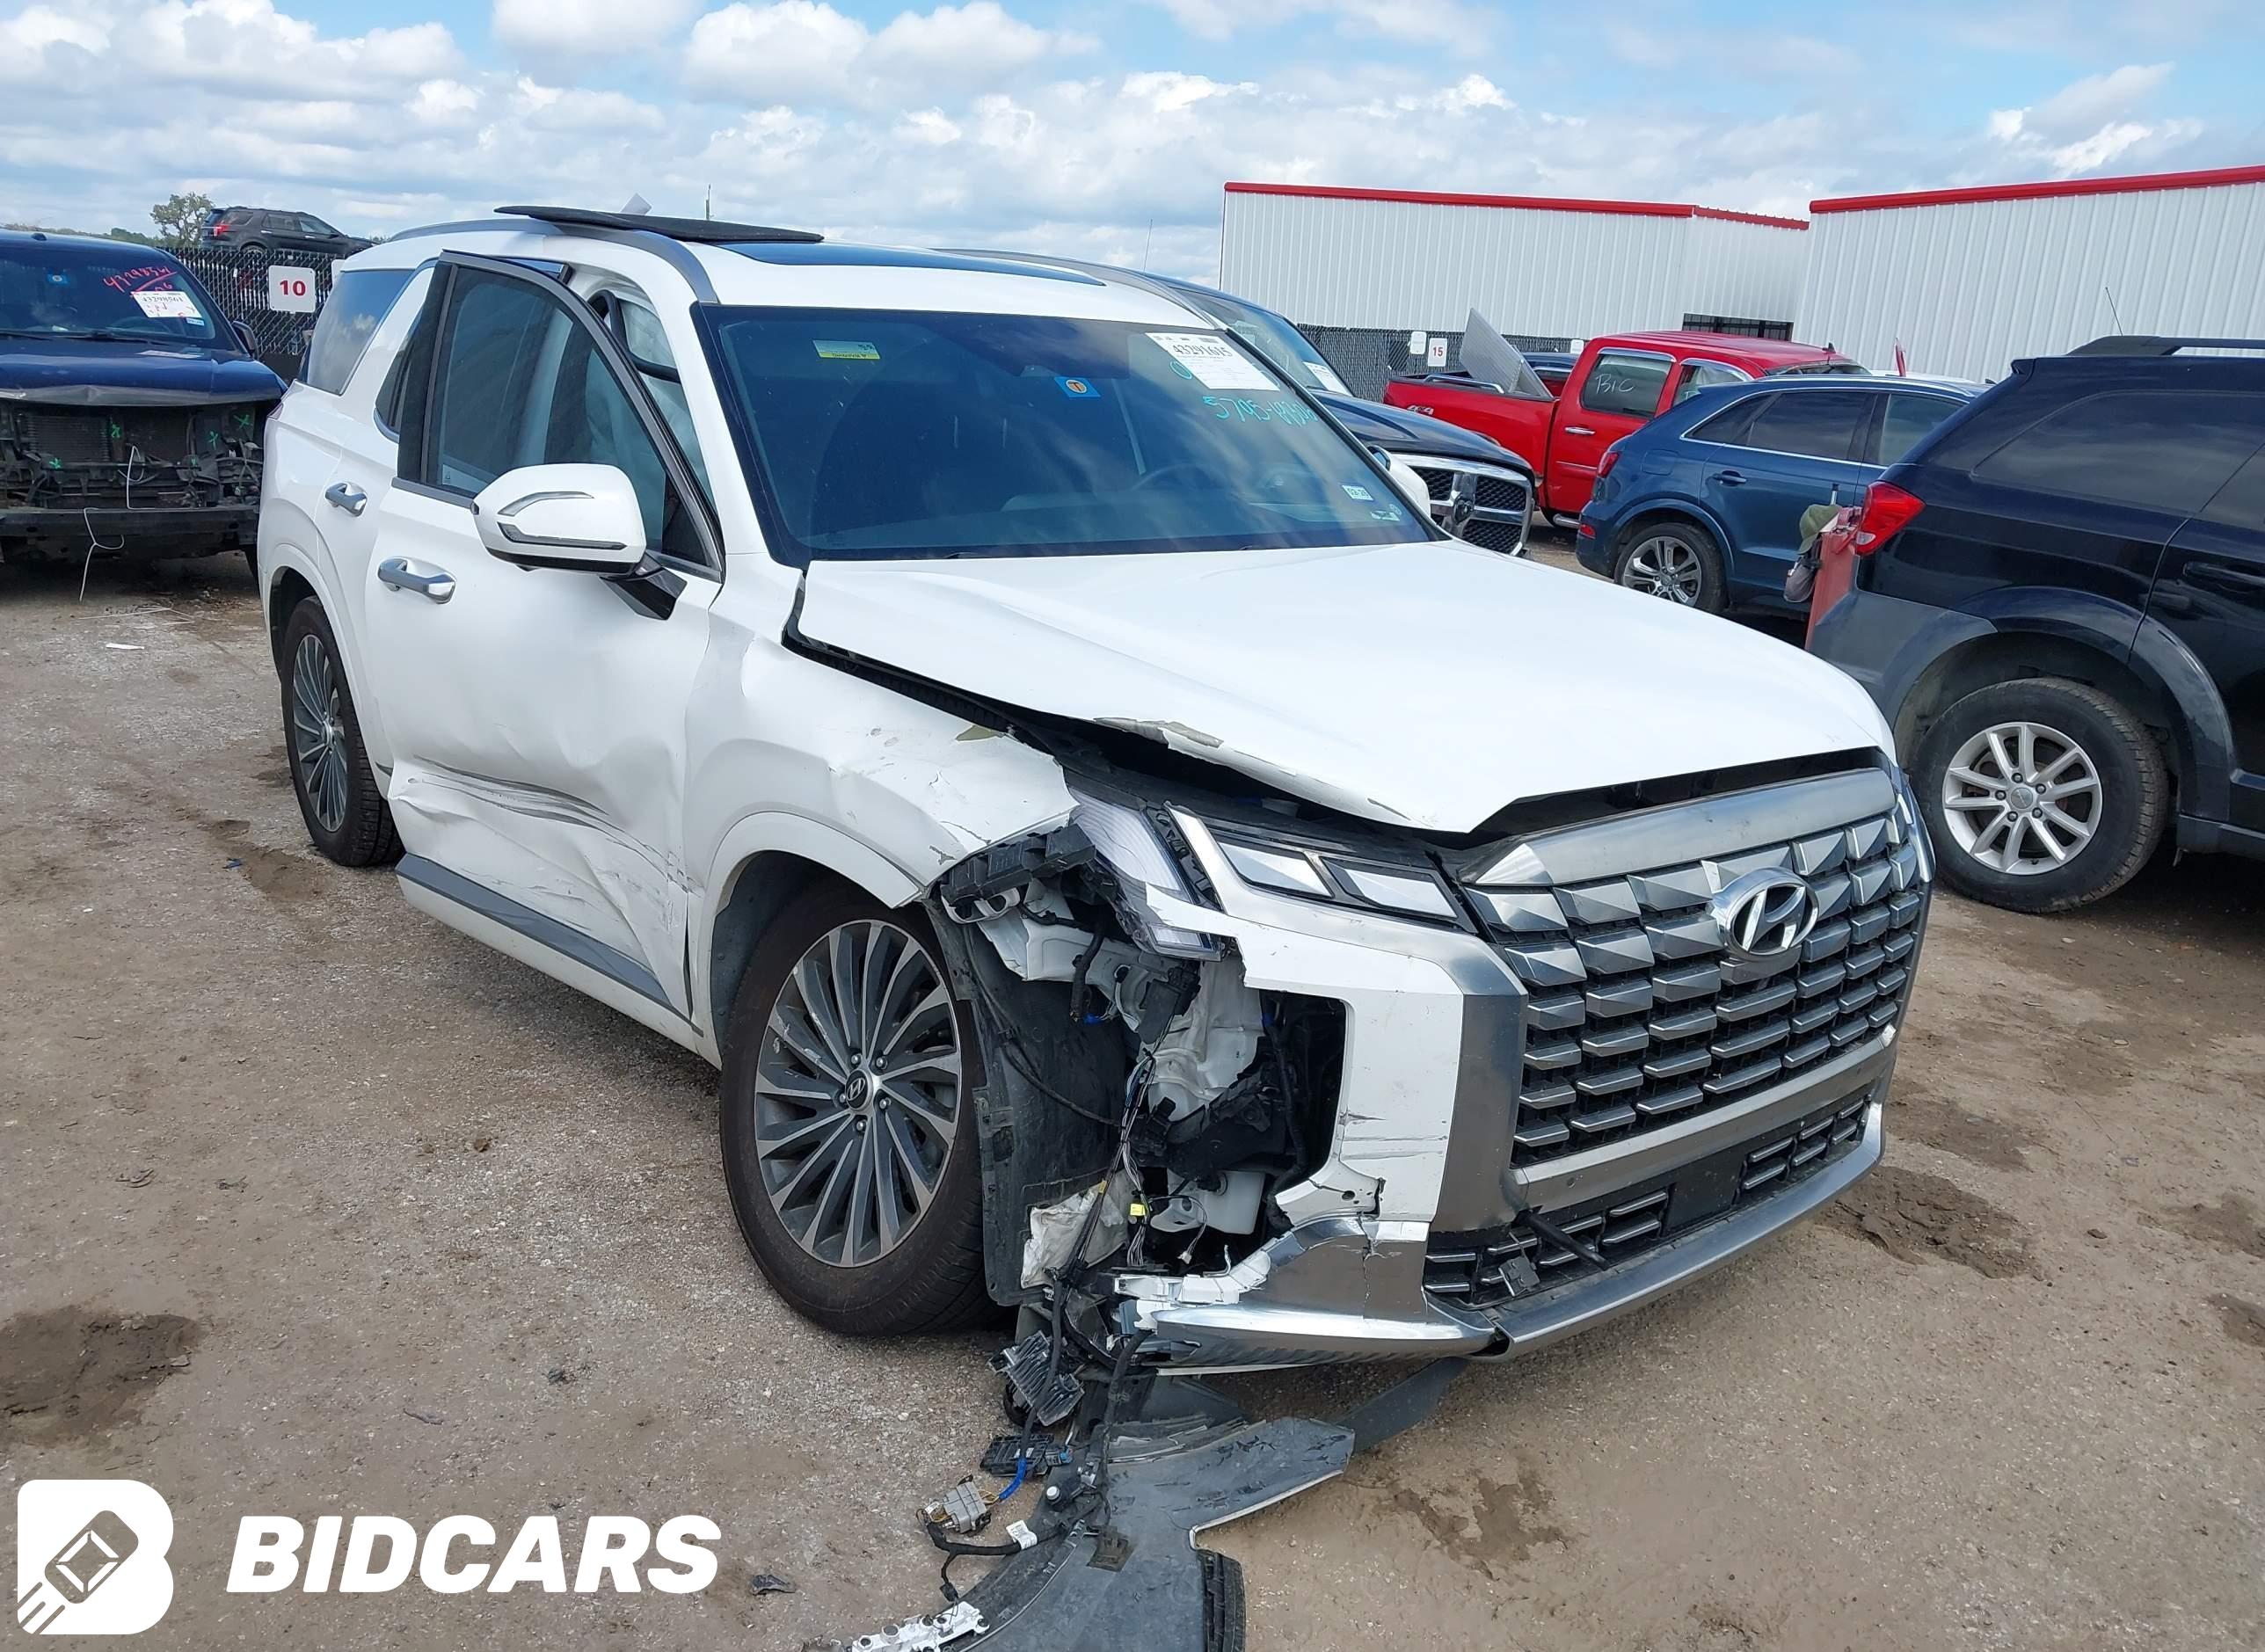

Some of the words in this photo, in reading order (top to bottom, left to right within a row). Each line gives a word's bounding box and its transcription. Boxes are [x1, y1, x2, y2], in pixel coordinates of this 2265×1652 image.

[280, 280, 306, 296] 10
[1171, 344, 1233, 357] 43291615
[1432, 346, 1444, 357] 15
